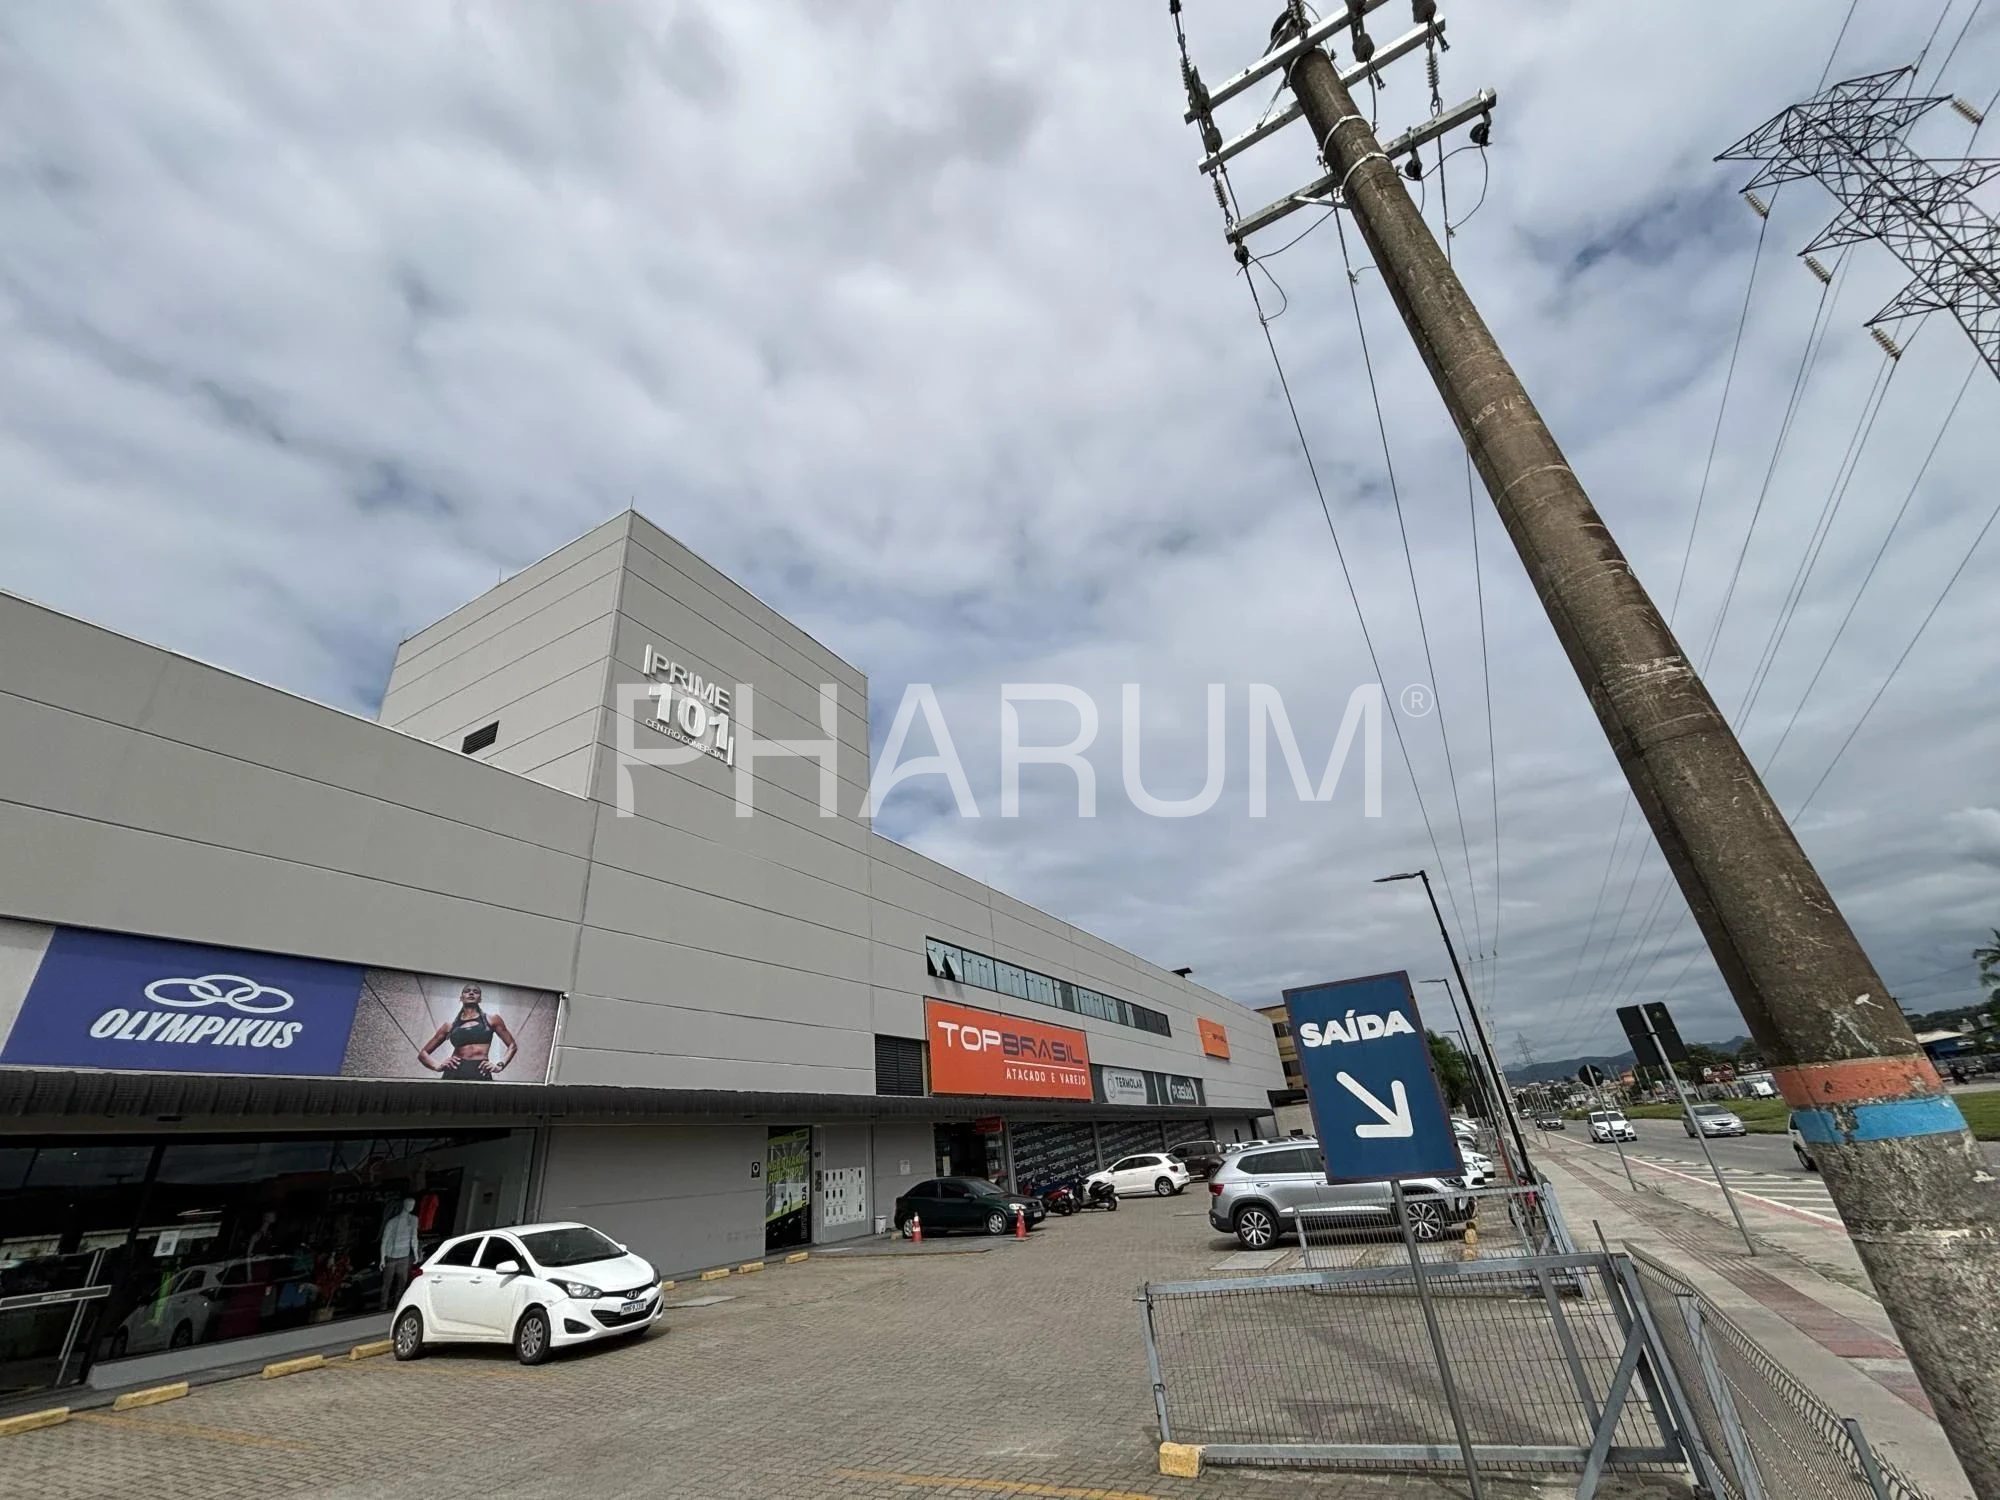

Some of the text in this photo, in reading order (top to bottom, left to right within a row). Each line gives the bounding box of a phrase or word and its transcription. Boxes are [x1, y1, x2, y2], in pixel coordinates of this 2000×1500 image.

[651, 652, 730, 712] PRIME
[648, 683, 729, 750] 101
[645, 718, 728, 761] CENTRO COMERCIAL
[90, 1008, 303, 1049] OLYMPIKUS
[1300, 1009, 1416, 1048] SAÍDA
[1006, 1067, 1046, 1082] ATACADO
[1060, 1073, 1086, 1086] VAREJO
[1115, 1076, 1144, 1089] TERMOLAR
